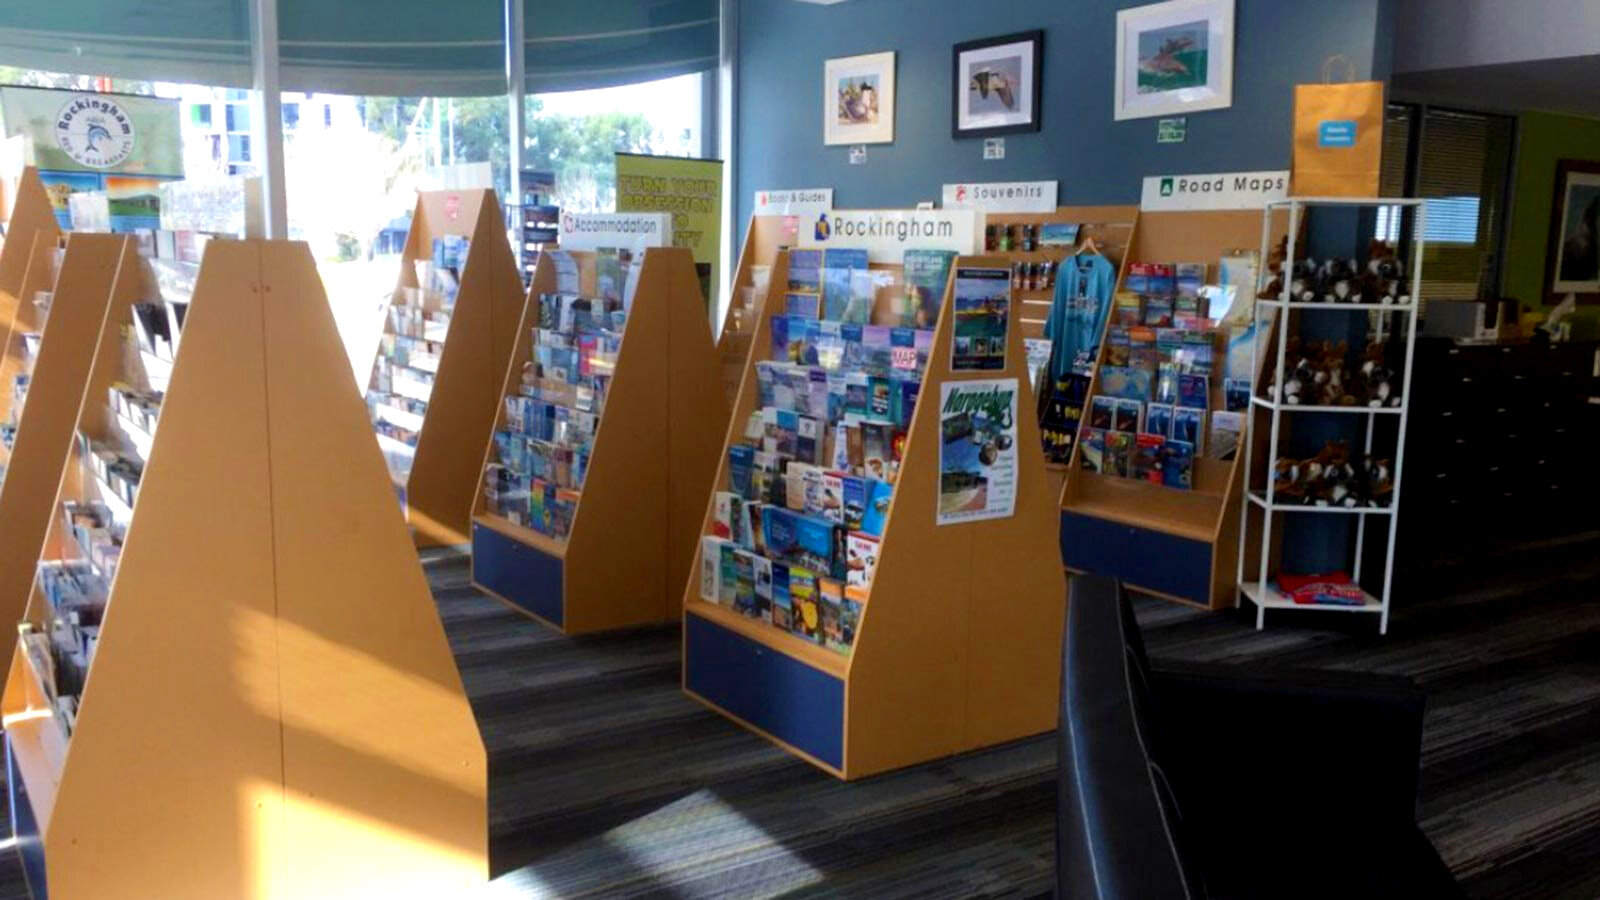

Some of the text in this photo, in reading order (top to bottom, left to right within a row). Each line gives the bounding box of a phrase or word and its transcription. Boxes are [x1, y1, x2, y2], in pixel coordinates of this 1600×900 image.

[58, 98, 130, 134] Rockingham
[620, 174, 667, 193] TURN
[1178, 177, 1284, 193] Road Maps
[799, 191, 826, 203] Guides
[973, 185, 1042, 199] Souvenirs
[621, 193, 713, 213] OBSESSION
[575, 218, 656, 234] Accommodation
[834, 216, 952, 241] Rockingham
[892, 349, 917, 363] MAP
